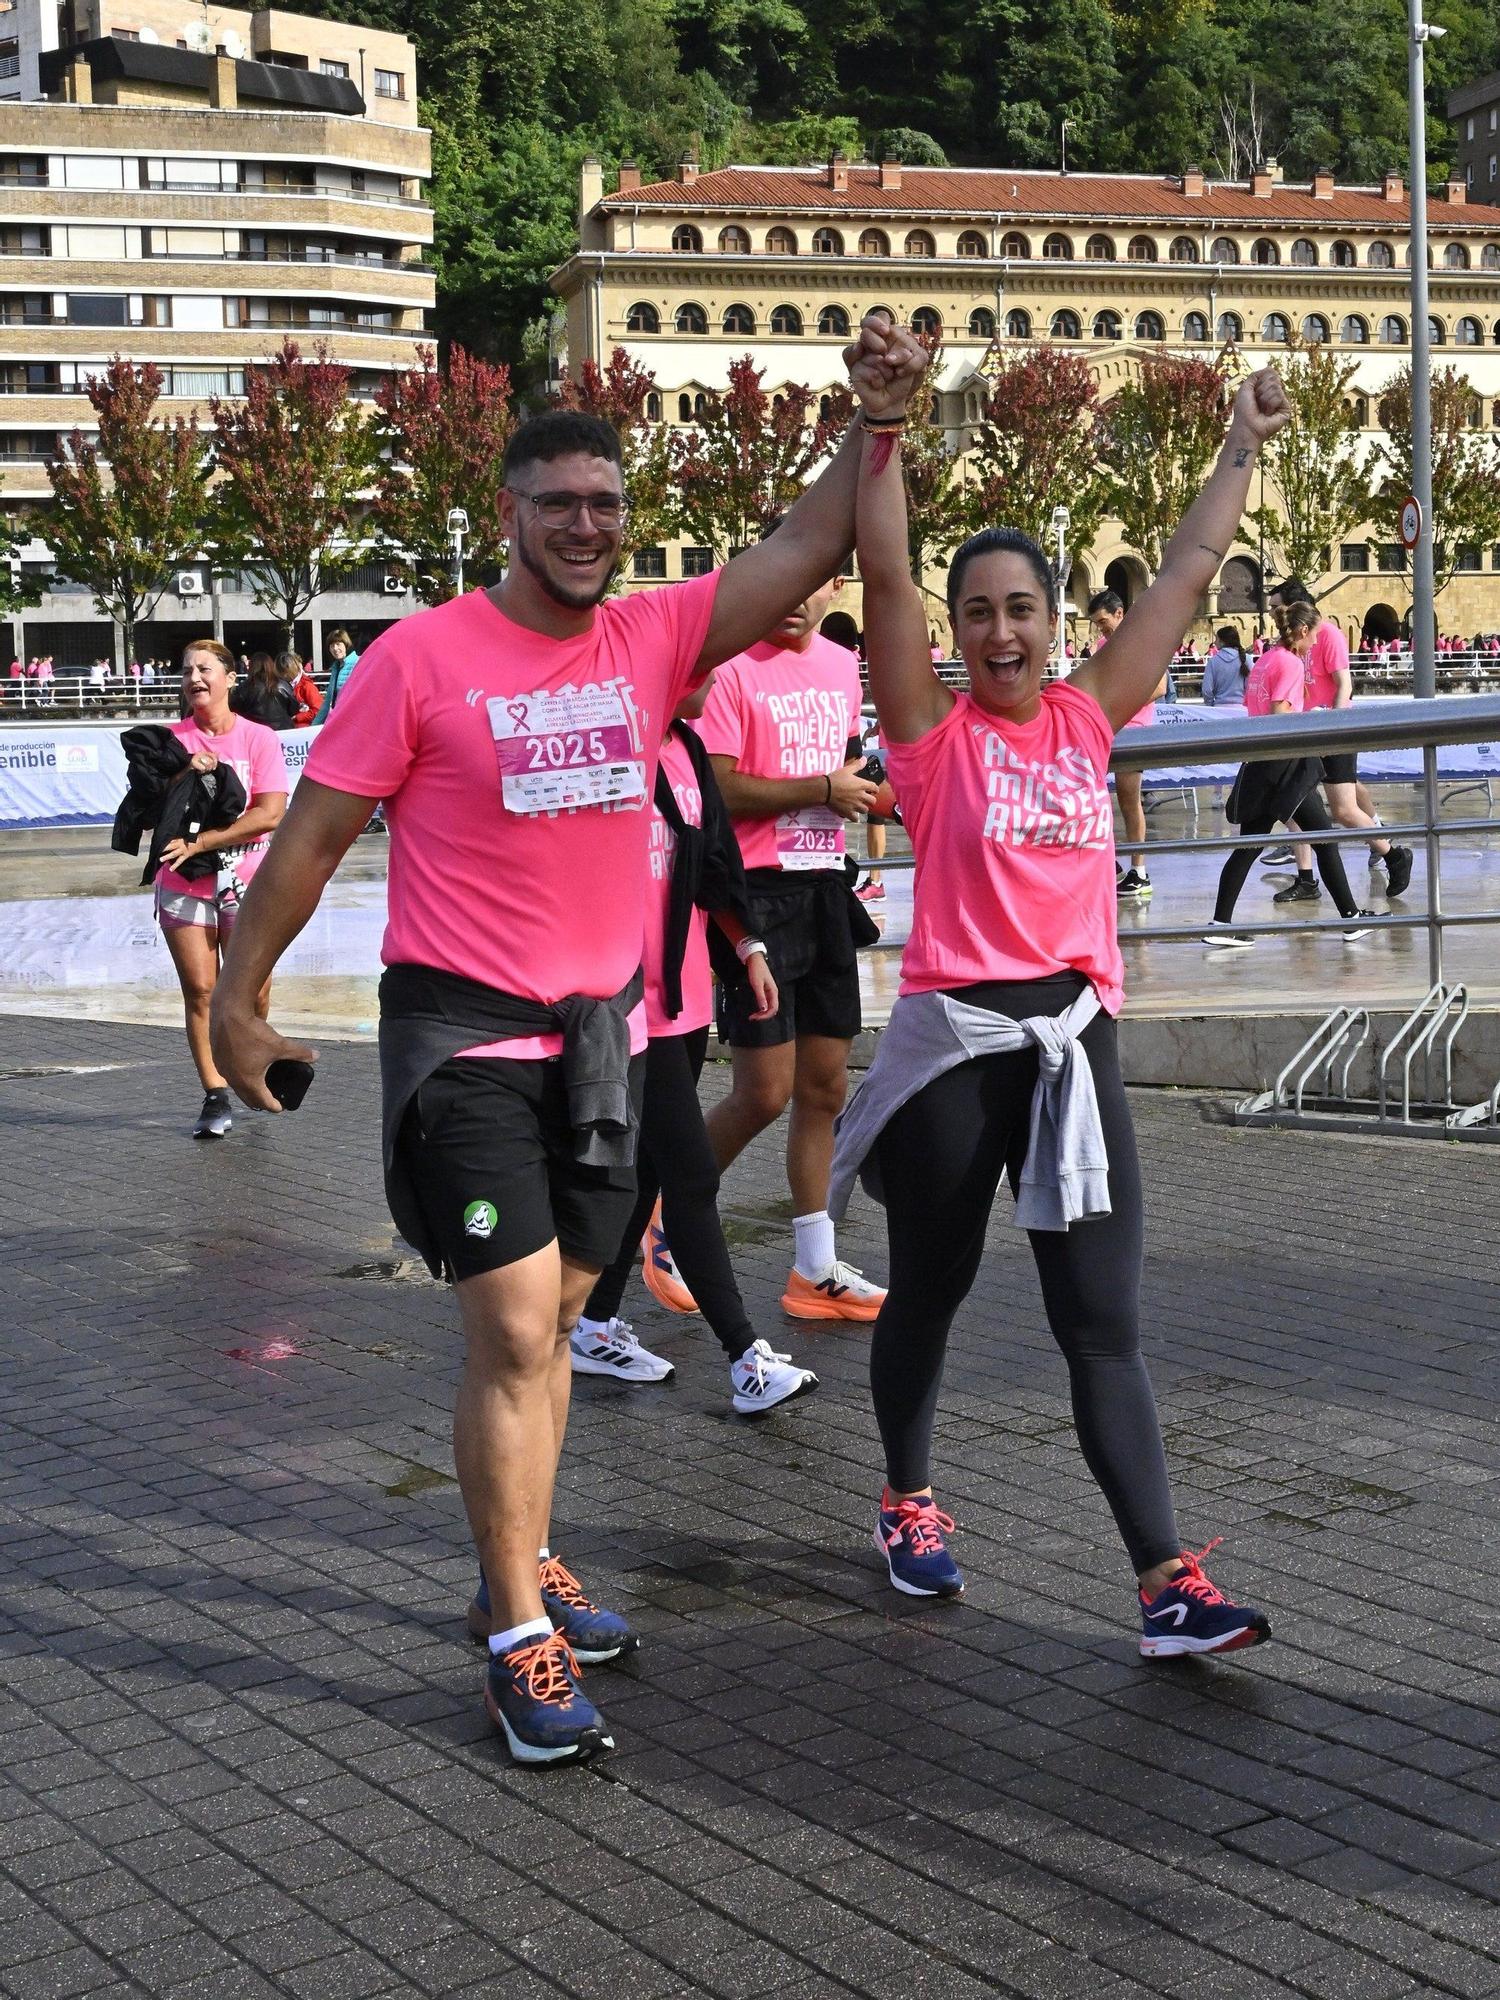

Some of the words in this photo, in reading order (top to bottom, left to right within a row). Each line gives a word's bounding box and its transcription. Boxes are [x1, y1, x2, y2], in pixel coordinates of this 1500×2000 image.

[11, 741, 55, 752] producción
[526, 731, 607, 769] 2025
[793, 829, 836, 850] 2025
